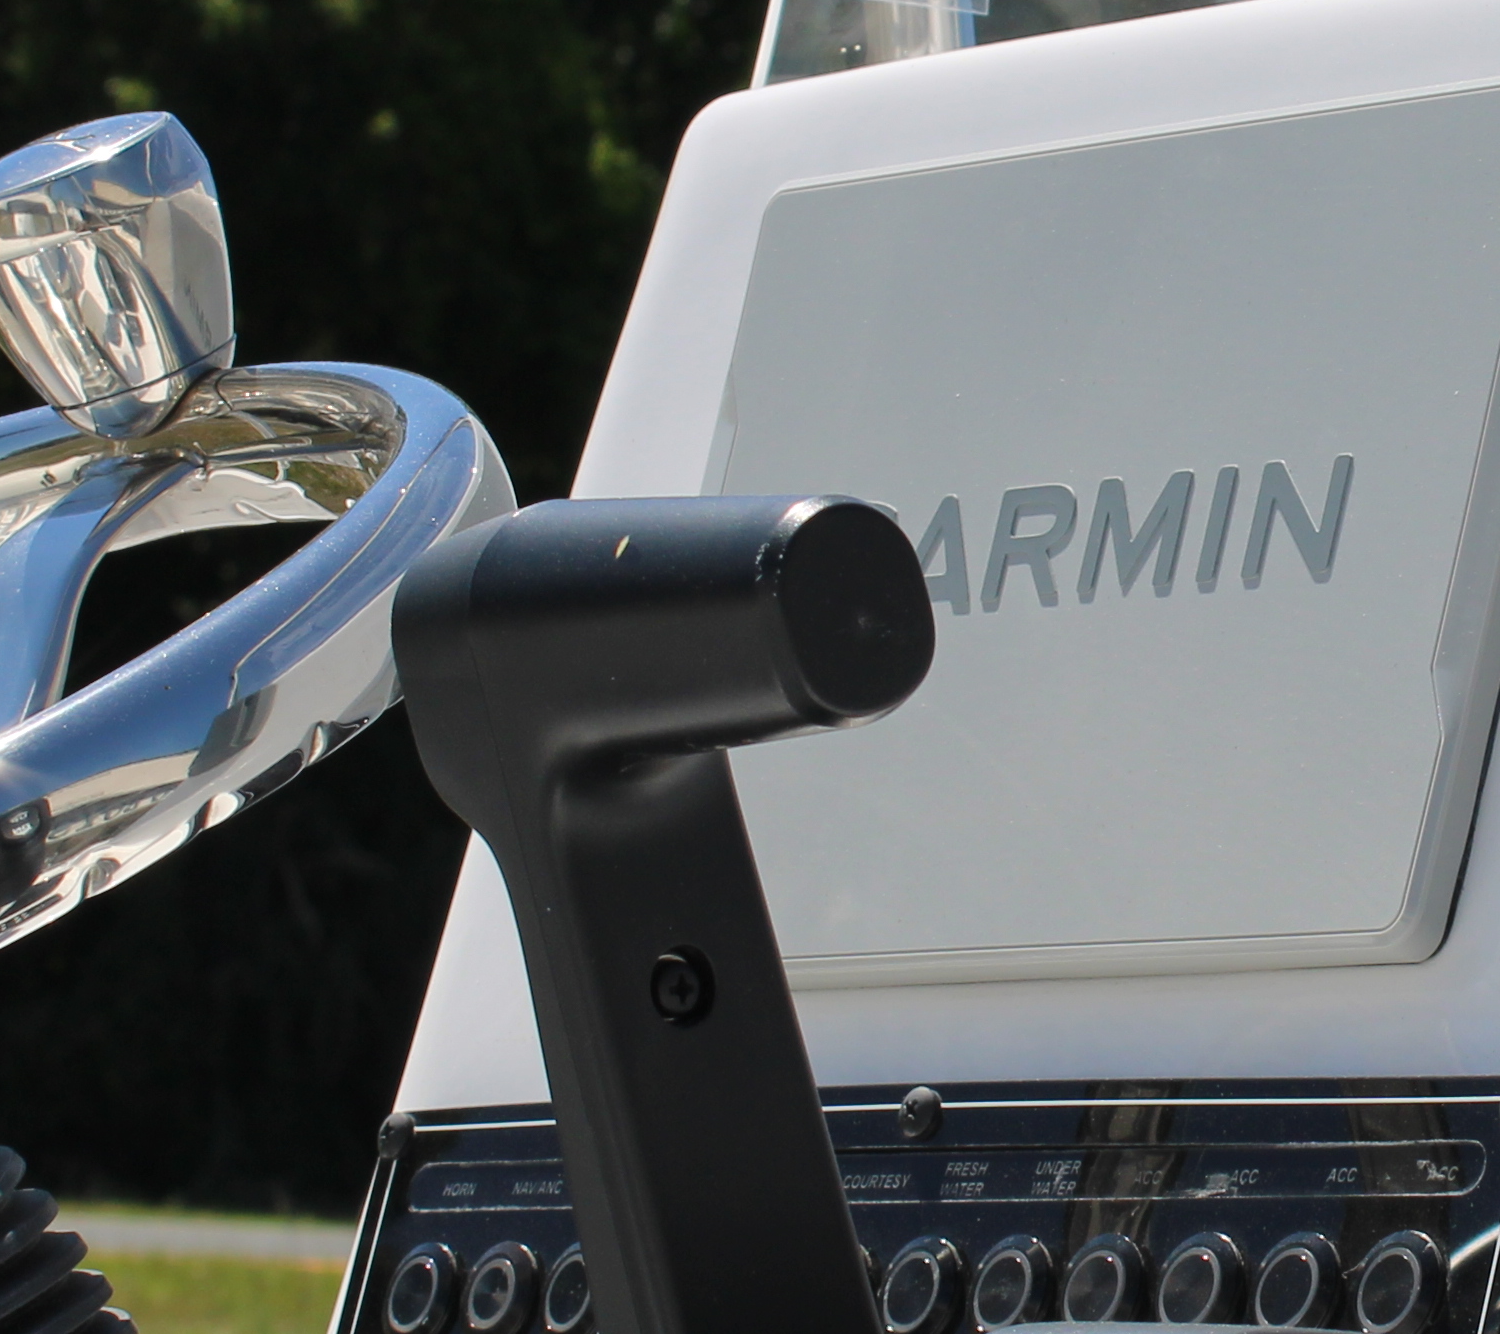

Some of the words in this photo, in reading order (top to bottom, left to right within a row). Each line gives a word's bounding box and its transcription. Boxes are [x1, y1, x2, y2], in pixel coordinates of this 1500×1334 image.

[918, 452, 1354, 614] ARMIN
[945, 1161, 989, 1177] FRESH
[1035, 1160, 1082, 1175] UNDER
[1326, 1167, 1358, 1183] ACC
[843, 1174, 911, 1189] COURTESY
[1134, 1170, 1162, 1185] ACC
[1229, 1169, 1260, 1186] ACC
[442, 1182, 477, 1196] HORN
[939, 1182, 985, 1197] WATER
[1031, 1181, 1077, 1196] WATER
